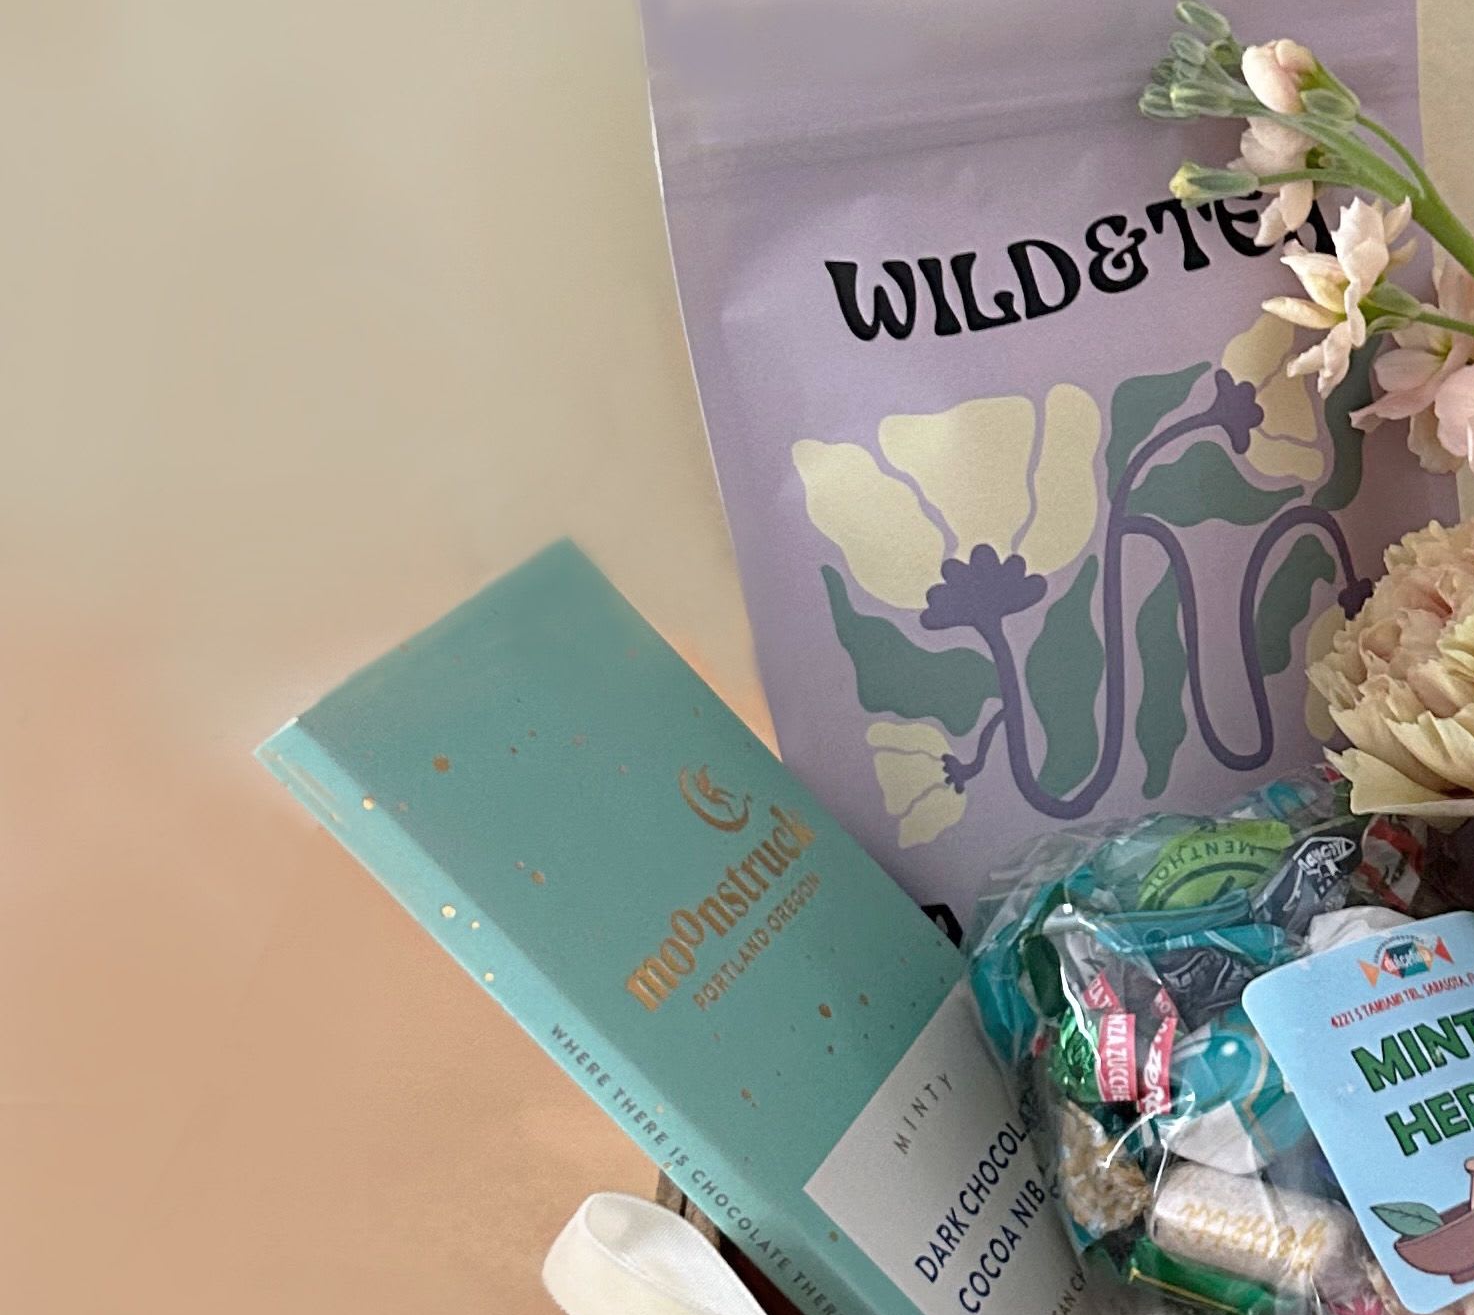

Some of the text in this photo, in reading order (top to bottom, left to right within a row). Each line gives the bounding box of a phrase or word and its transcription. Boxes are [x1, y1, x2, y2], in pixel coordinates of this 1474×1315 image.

[626, 804, 816, 1012] moonstruck
[693, 871, 821, 1011] PORTLAND OREGON
[1362, 992, 1404, 1018] TAMIAMI
[552, 1023, 611, 1087] WHERE
[613, 1087, 670, 1146] THERE
[669, 1146, 690, 1167] IS
[691, 1169, 791, 1271] CHOCOLATE
[893, 1072, 953, 1155] MINTY
[914, 1206, 970, 1283] DARK
[959, 1224, 1022, 1314] COCOA
